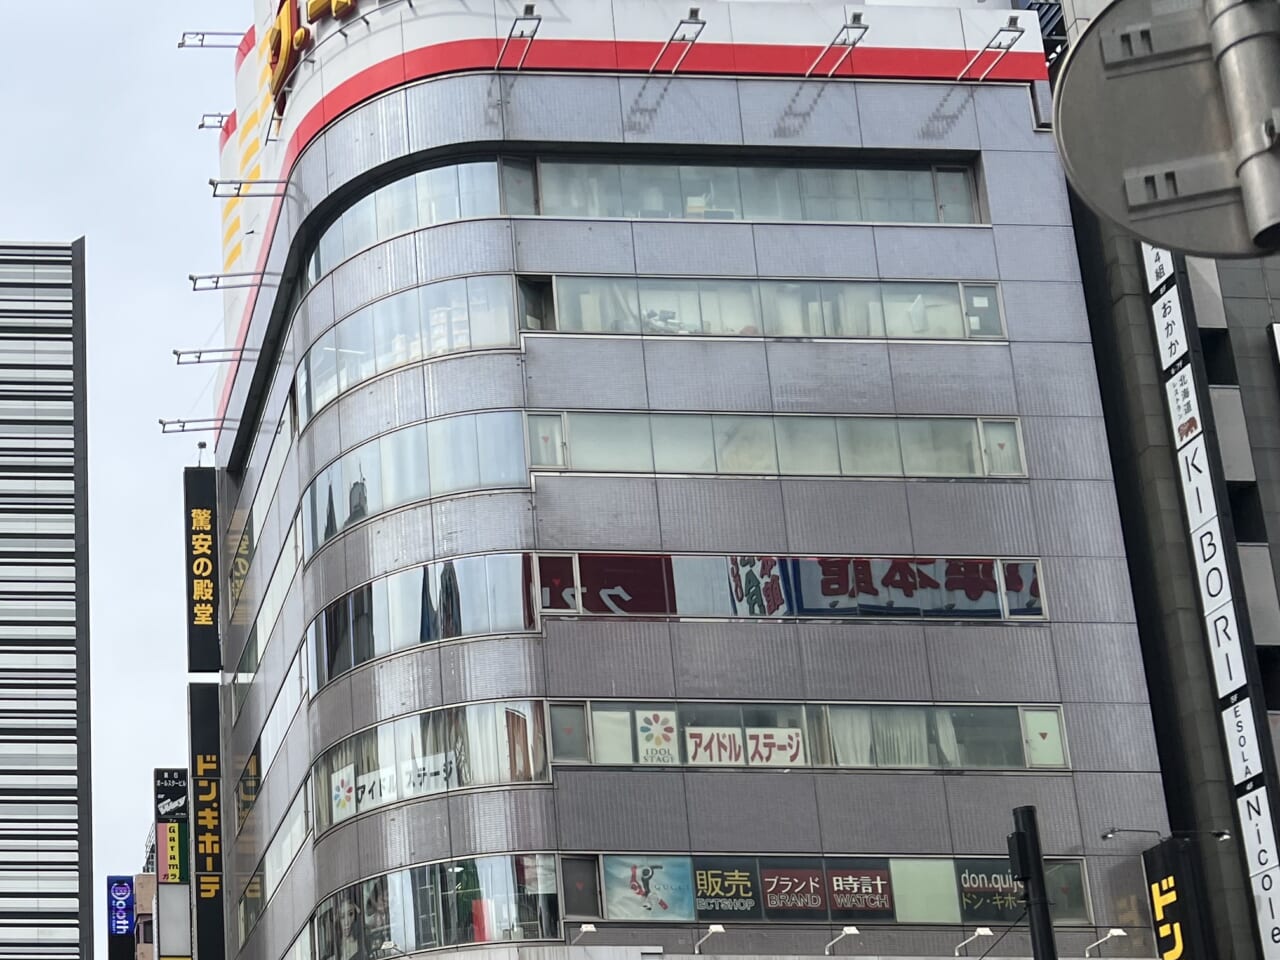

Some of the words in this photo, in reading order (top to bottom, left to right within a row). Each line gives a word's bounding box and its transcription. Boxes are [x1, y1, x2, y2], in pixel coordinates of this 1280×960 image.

[1161, 300, 1180, 358] おかか
[190, 508, 214, 627] 驚安の殿堂
[1184, 447, 1232, 682] KIBORI
[646, 748, 673, 757] IDOL
[688, 732, 742, 763] アイドル
[748, 732, 802, 763] ステージ
[1232, 704, 1254, 778] ESOLA
[168, 825, 179, 870] Garam
[196, 754, 221, 899] ドン・キホーテ
[695, 869, 754, 898] 販売
[764, 876, 820, 894] ブランド
[831, 875, 888, 894] 時計
[1246, 795, 1280, 945] Nicole
[766, 895, 822, 908] BRAND
[833, 895, 889, 909] WATCH
